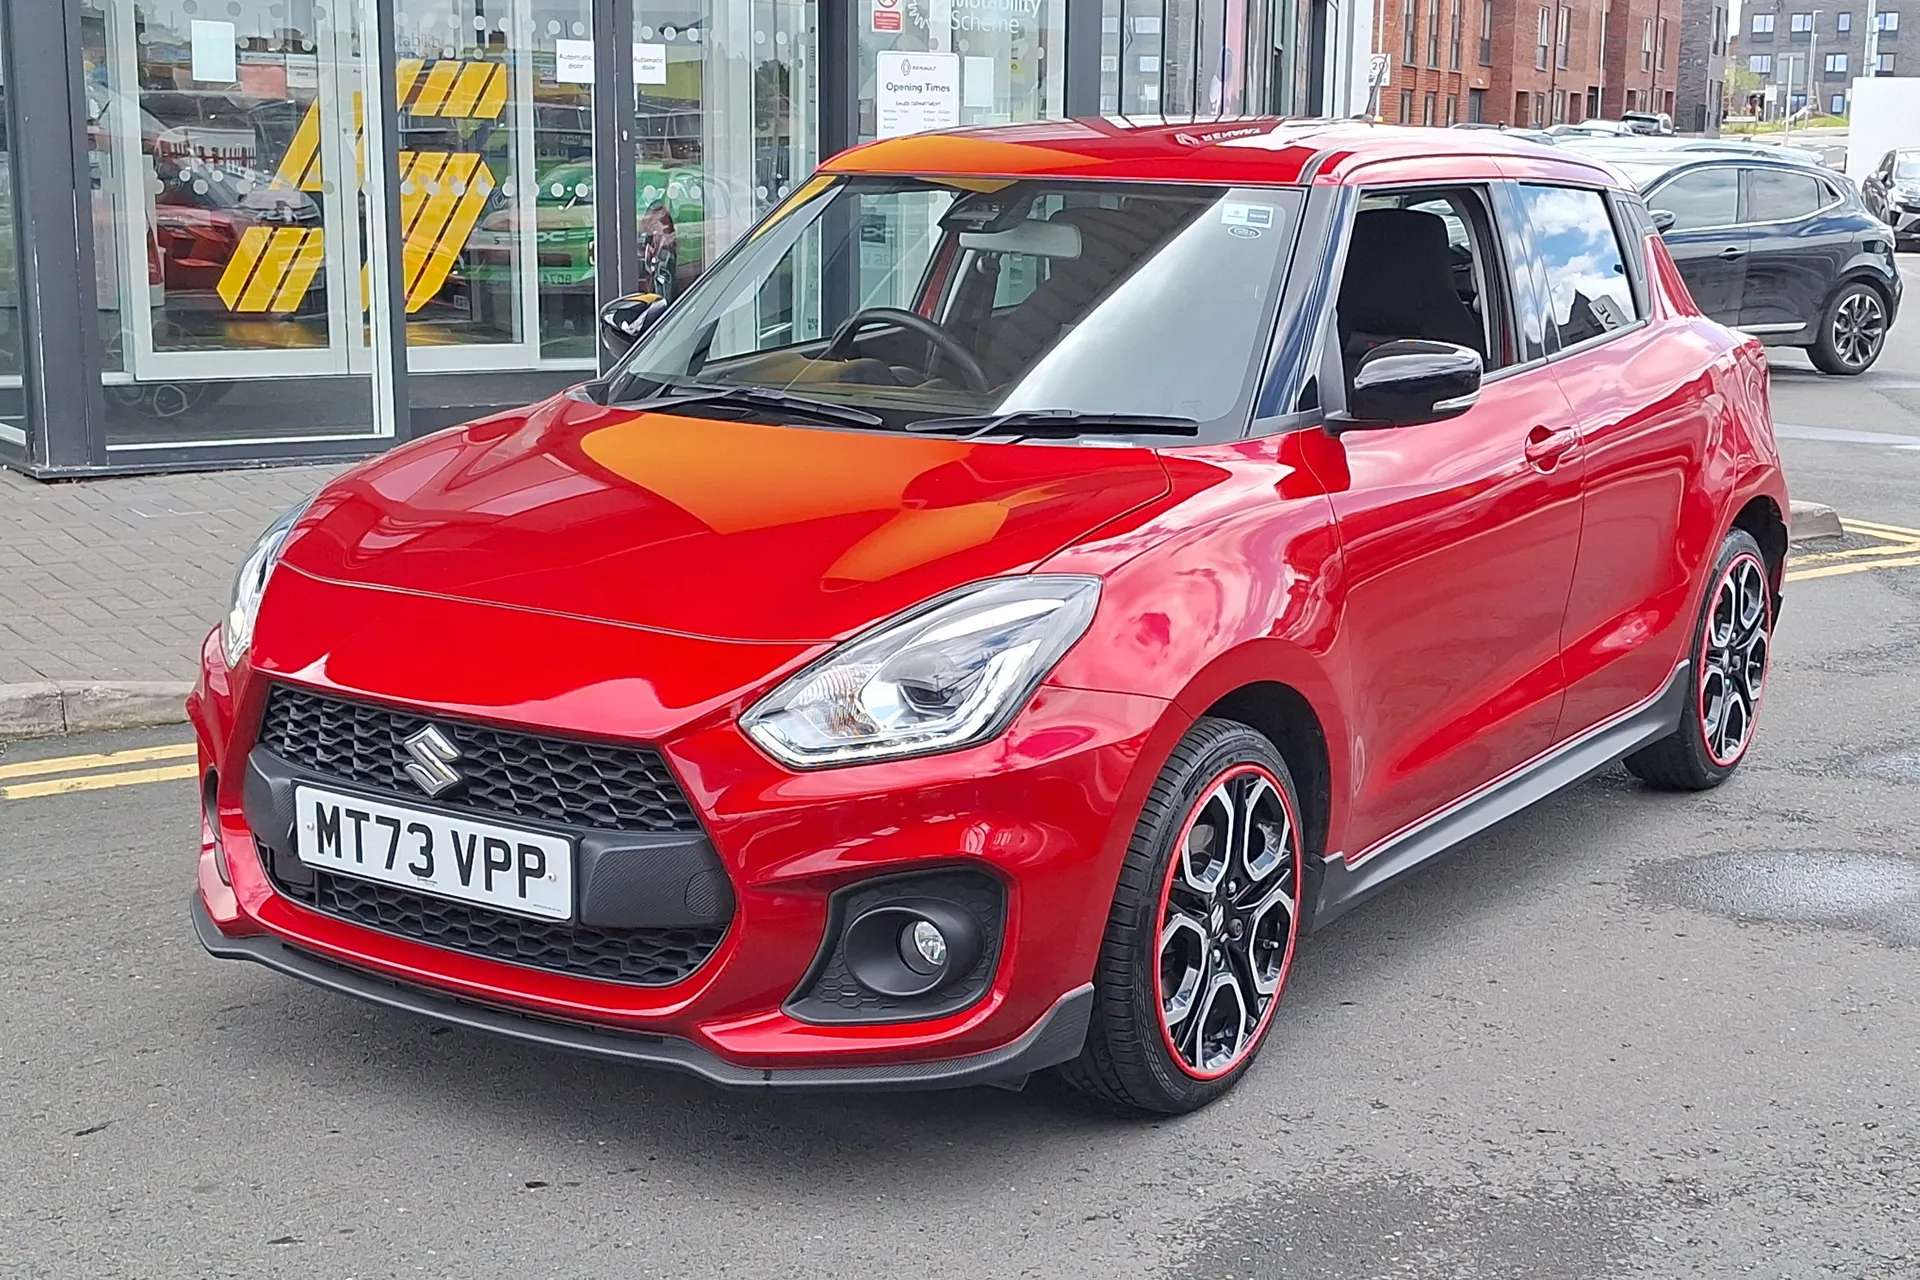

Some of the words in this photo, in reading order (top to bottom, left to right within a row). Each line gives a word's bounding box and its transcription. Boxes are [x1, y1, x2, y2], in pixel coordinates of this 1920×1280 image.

[951, 10, 1020, 34] Scheme
[886, 82, 923, 94] Opening
[925, 82, 951, 93] Times
[315, 801, 434, 879] MT73
[450, 829, 547, 899] VPP
